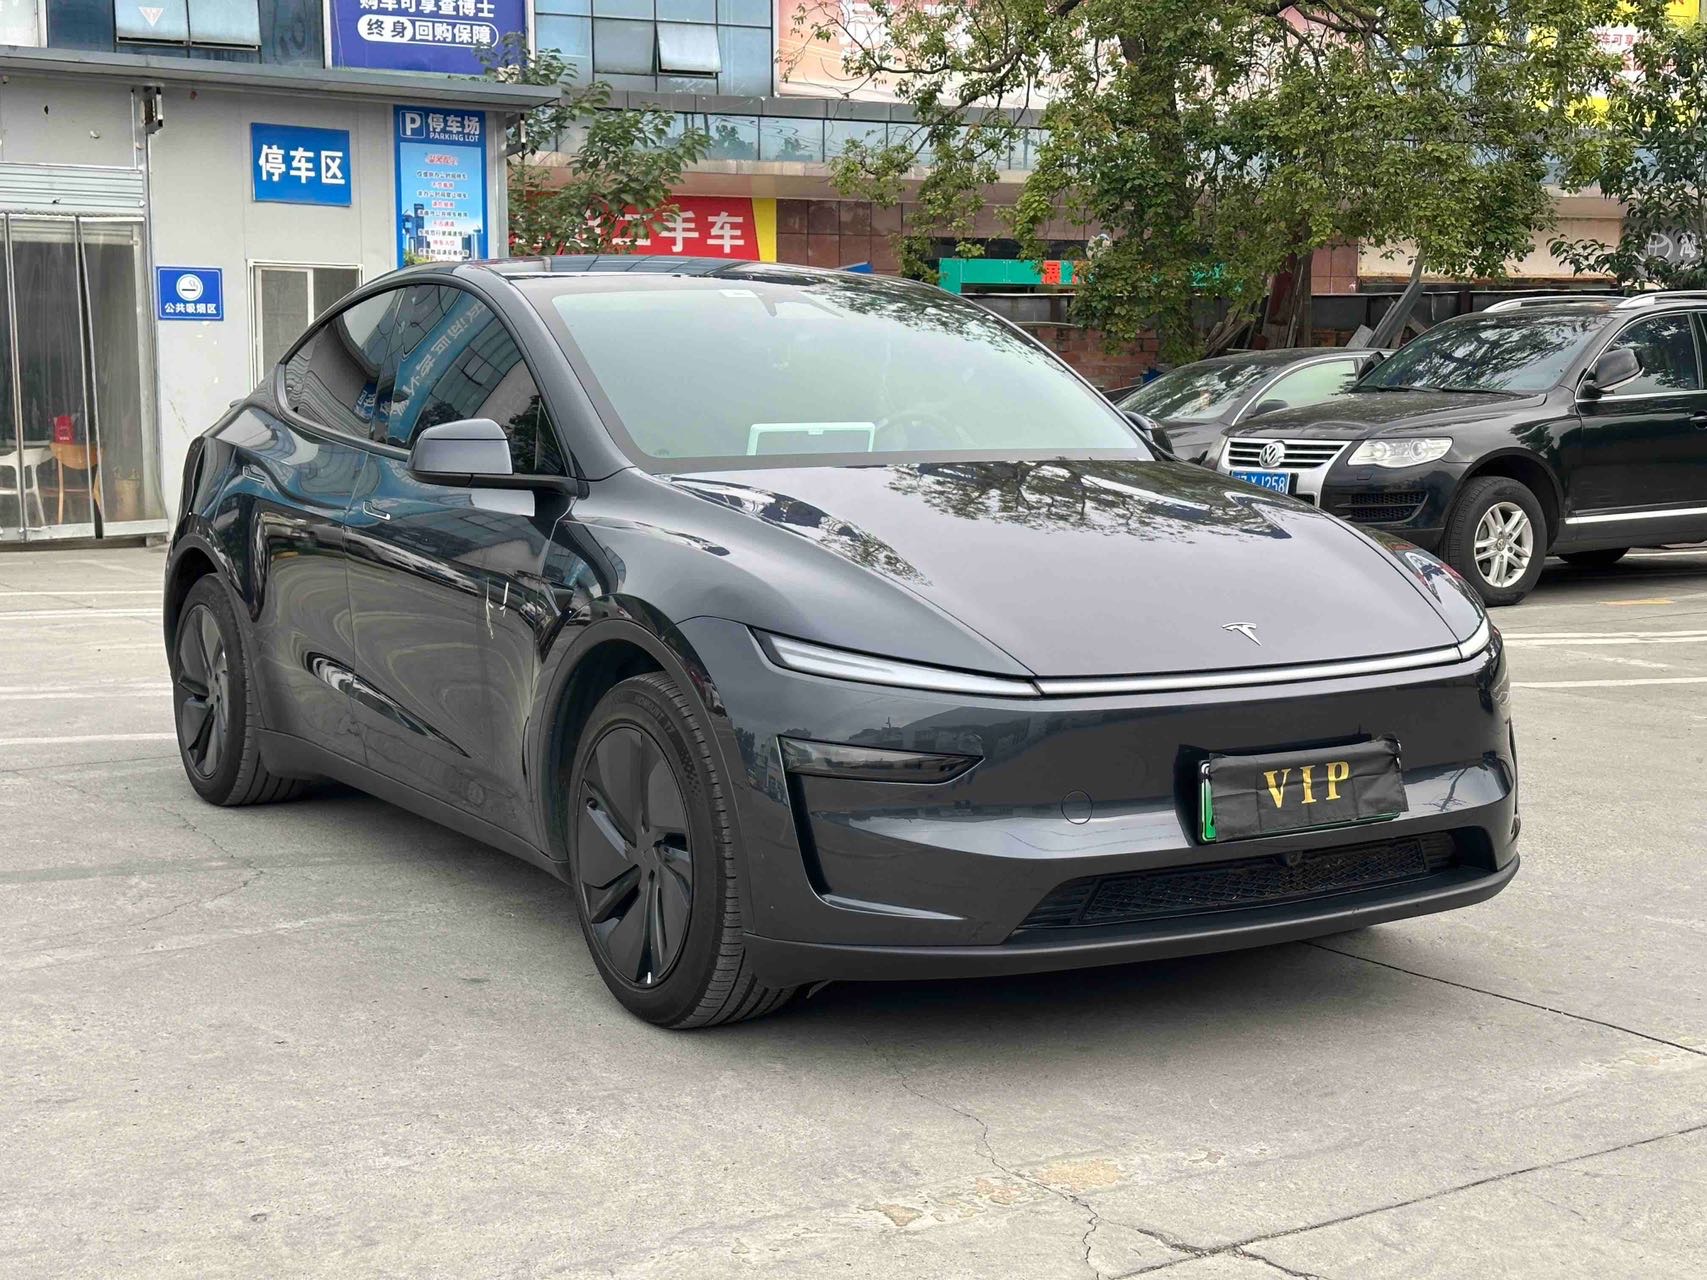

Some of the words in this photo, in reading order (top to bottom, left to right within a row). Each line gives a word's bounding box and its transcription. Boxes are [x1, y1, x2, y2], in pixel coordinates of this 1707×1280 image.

[405, 113, 420, 136] P
[428, 113, 480, 135] 停车场
[429, 132, 463, 142] PARKING
[258, 144, 345, 185] 停车区
[164, 302, 217, 314] 公共吸烟区
[1264, 761, 1350, 809] VIP
